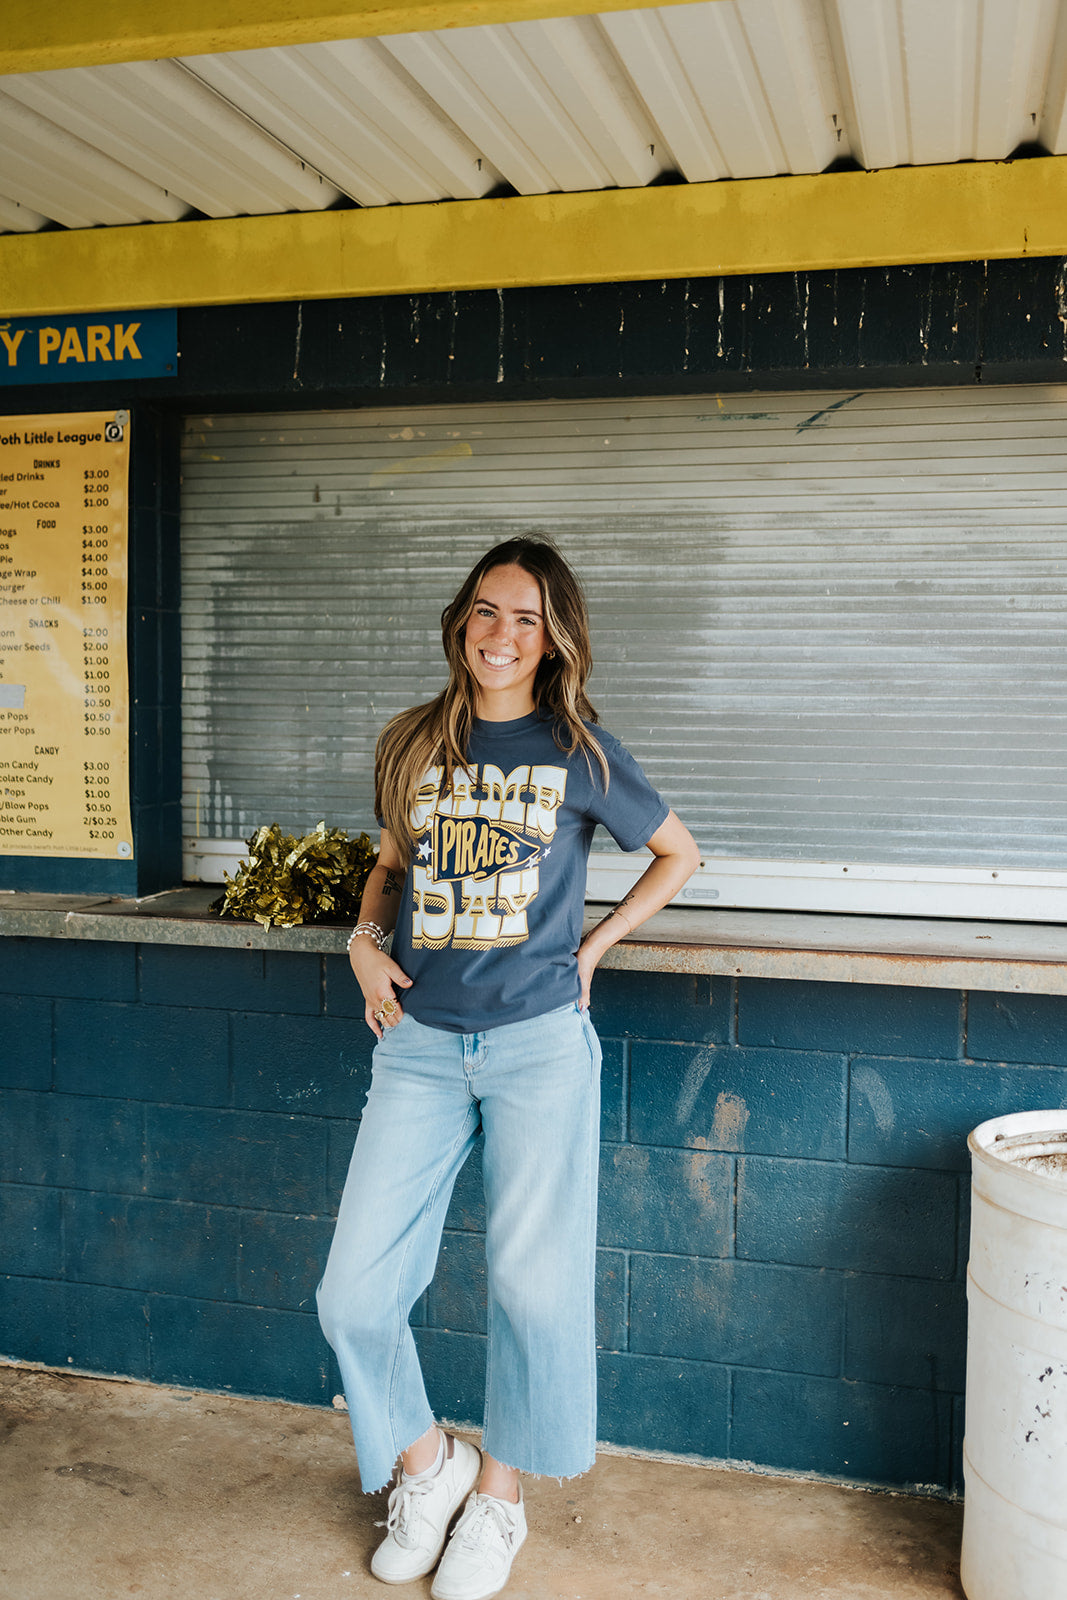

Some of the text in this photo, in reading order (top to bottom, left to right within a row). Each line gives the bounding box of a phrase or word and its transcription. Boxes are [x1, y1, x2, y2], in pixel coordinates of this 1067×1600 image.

[0, 323, 142, 366] Y PARK
[0, 433, 20, 445] oth
[25, 432, 53, 444] Little
[58, 432, 101, 445] League
[17, 473, 44, 481] Drinks
[84, 470, 109, 479] $3.00
[84, 484, 109, 493] $2.00
[33, 500, 60, 508] Cocoa
[84, 498, 109, 507] $1.00
[83, 526, 108, 534] $3.00
[82, 540, 108, 548] $4.00
[82, 554, 108, 563] $4.00
[14, 569, 36, 578] Wrap
[82, 568, 108, 576] $4.00
[82, 582, 107, 590] $5.00
[0, 597, 27, 606] Cheese
[41, 596, 61, 605] Chili
[82, 596, 106, 605] $1.00
[83, 628, 108, 637] $2.00
[25, 642, 50, 651] Seeds
[83, 642, 108, 651] $2.00
[84, 656, 108, 665] $1.00
[84, 671, 109, 679] $1.00
[85, 684, 110, 694] $1.00
[84, 699, 111, 708] $0.50
[8, 712, 28, 721] Pops
[84, 713, 111, 722] $0.50
[14, 726, 35, 736] Pops
[84, 727, 110, 736] $0.50
[12, 760, 39, 770] Candy
[84, 762, 110, 770] $3.00
[27, 775, 54, 785] Candy
[84, 776, 110, 784] $2.00
[5, 788, 25, 798] Pops
[85, 790, 110, 798] $1.00
[28, 802, 49, 812] Pops
[86, 803, 112, 812] $0.50
[0, 814, 14, 823] ble
[83, 817, 117, 826] 2/$0.25
[26, 828, 53, 838] Candy
[89, 830, 114, 839] $2.00
[441, 819, 521, 875] PIRATES
[412, 865, 539, 951] DAY
